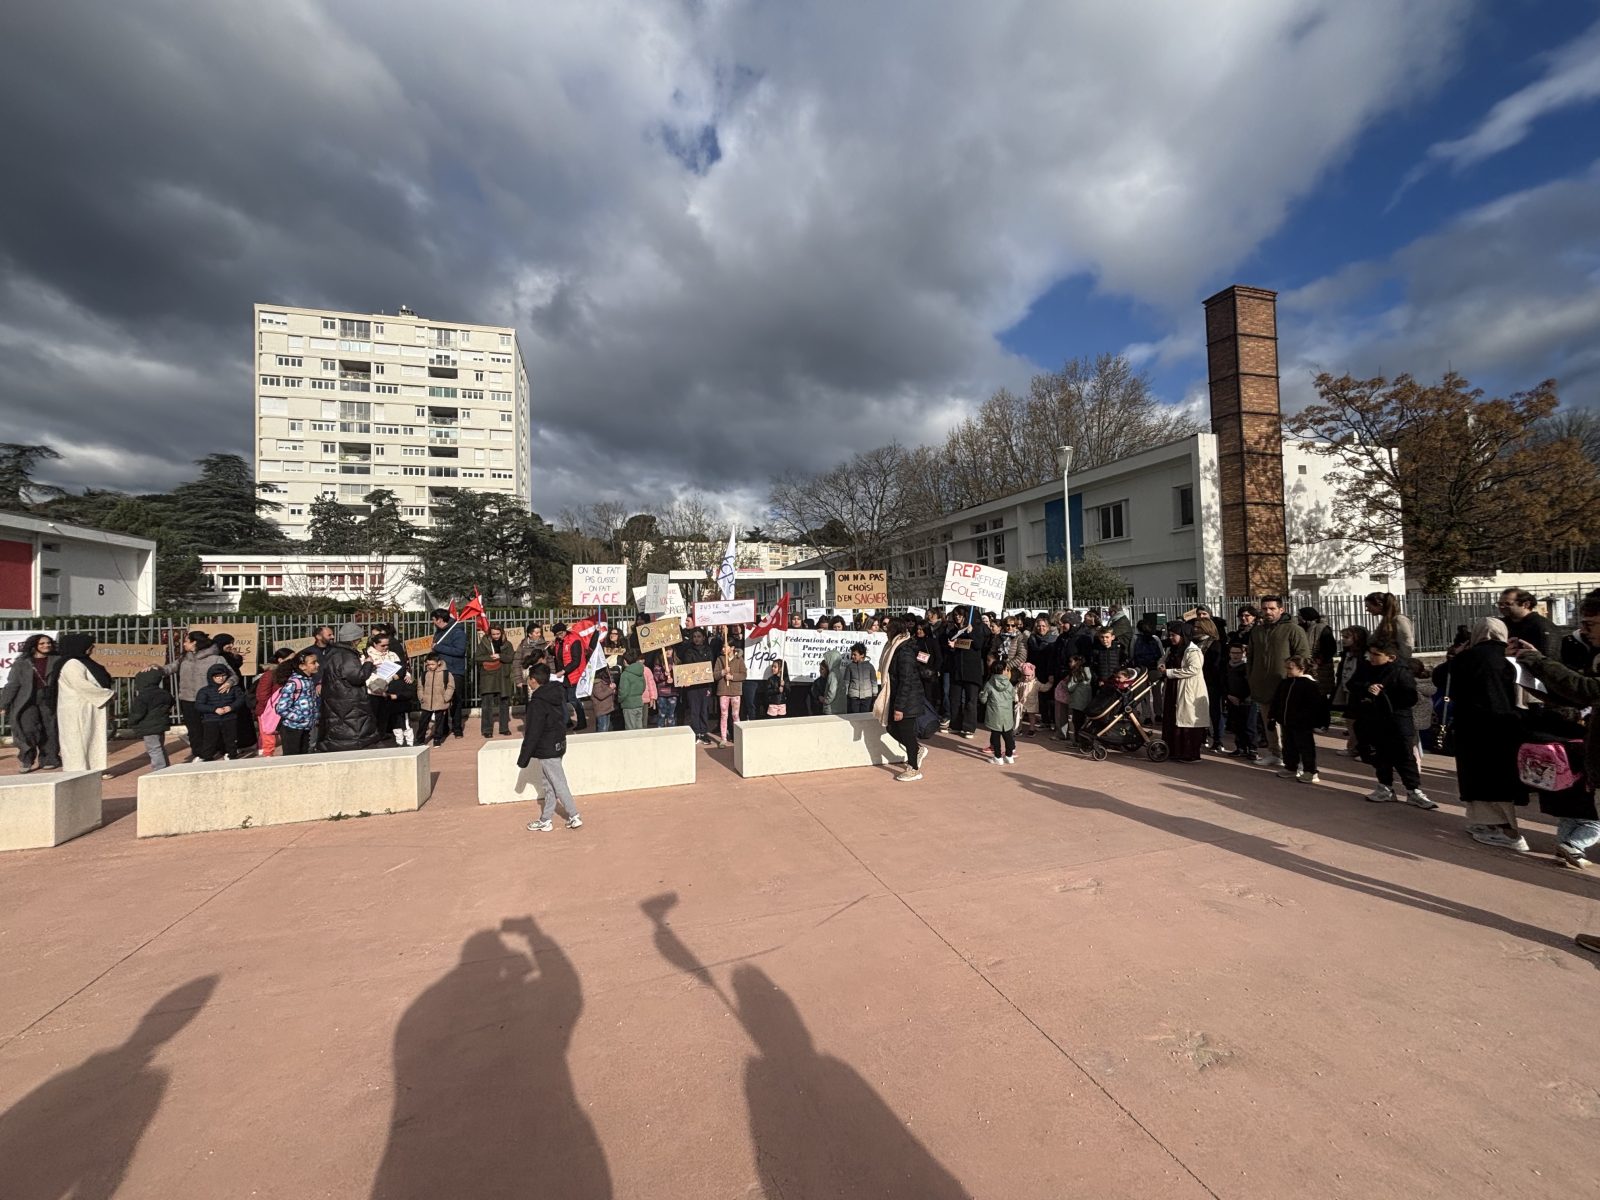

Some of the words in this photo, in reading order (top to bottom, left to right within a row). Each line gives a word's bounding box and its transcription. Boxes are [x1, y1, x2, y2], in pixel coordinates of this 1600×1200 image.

[838, 574, 849, 582] ON
[869, 573, 884, 581] PAS
[953, 563, 981, 578] REP
[98, 583, 105, 596] B
[748, 642, 777, 669] fcpe
